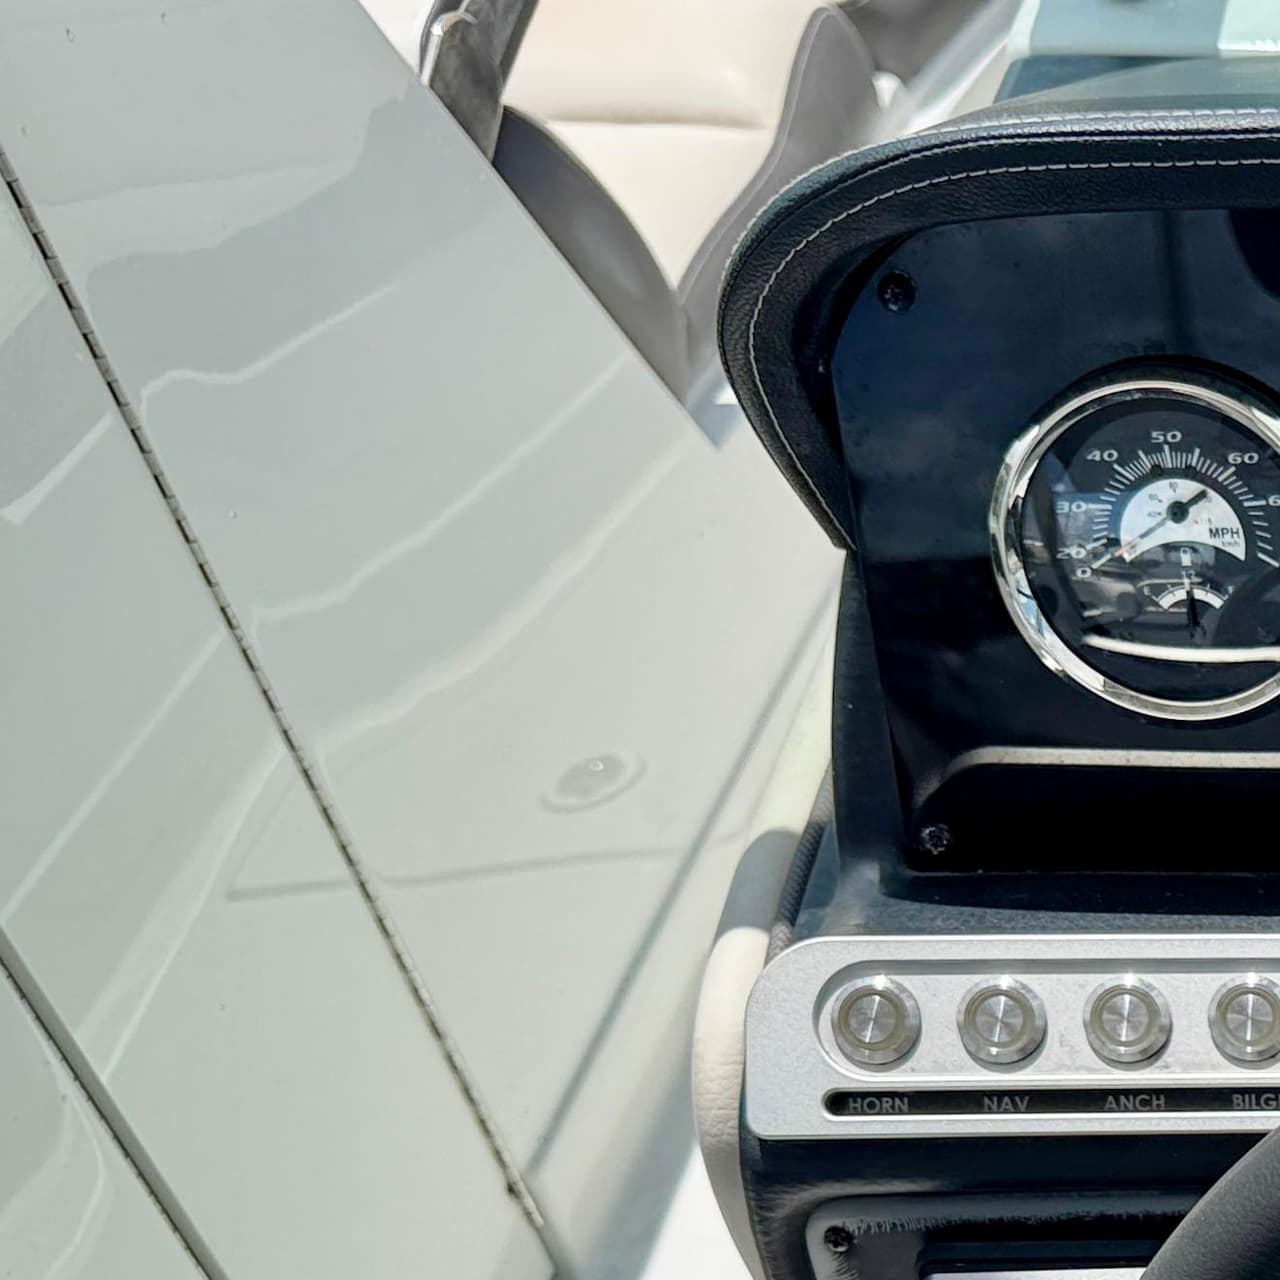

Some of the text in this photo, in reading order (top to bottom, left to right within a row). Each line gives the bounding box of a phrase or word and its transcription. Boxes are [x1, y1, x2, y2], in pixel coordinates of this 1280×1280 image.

[1151, 431, 1182, 443] 50
[1086, 449, 1118, 462] 40
[1228, 452, 1259, 465] 60
[1056, 500, 1088, 513] 30
[1209, 527, 1240, 540] MPH
[1057, 547, 1087, 560] 20
[1077, 568, 1092, 578] 0
[850, 1097, 909, 1113] HORN
[983, 1096, 1030, 1112] NAV
[1103, 1094, 1165, 1112] ANCH
